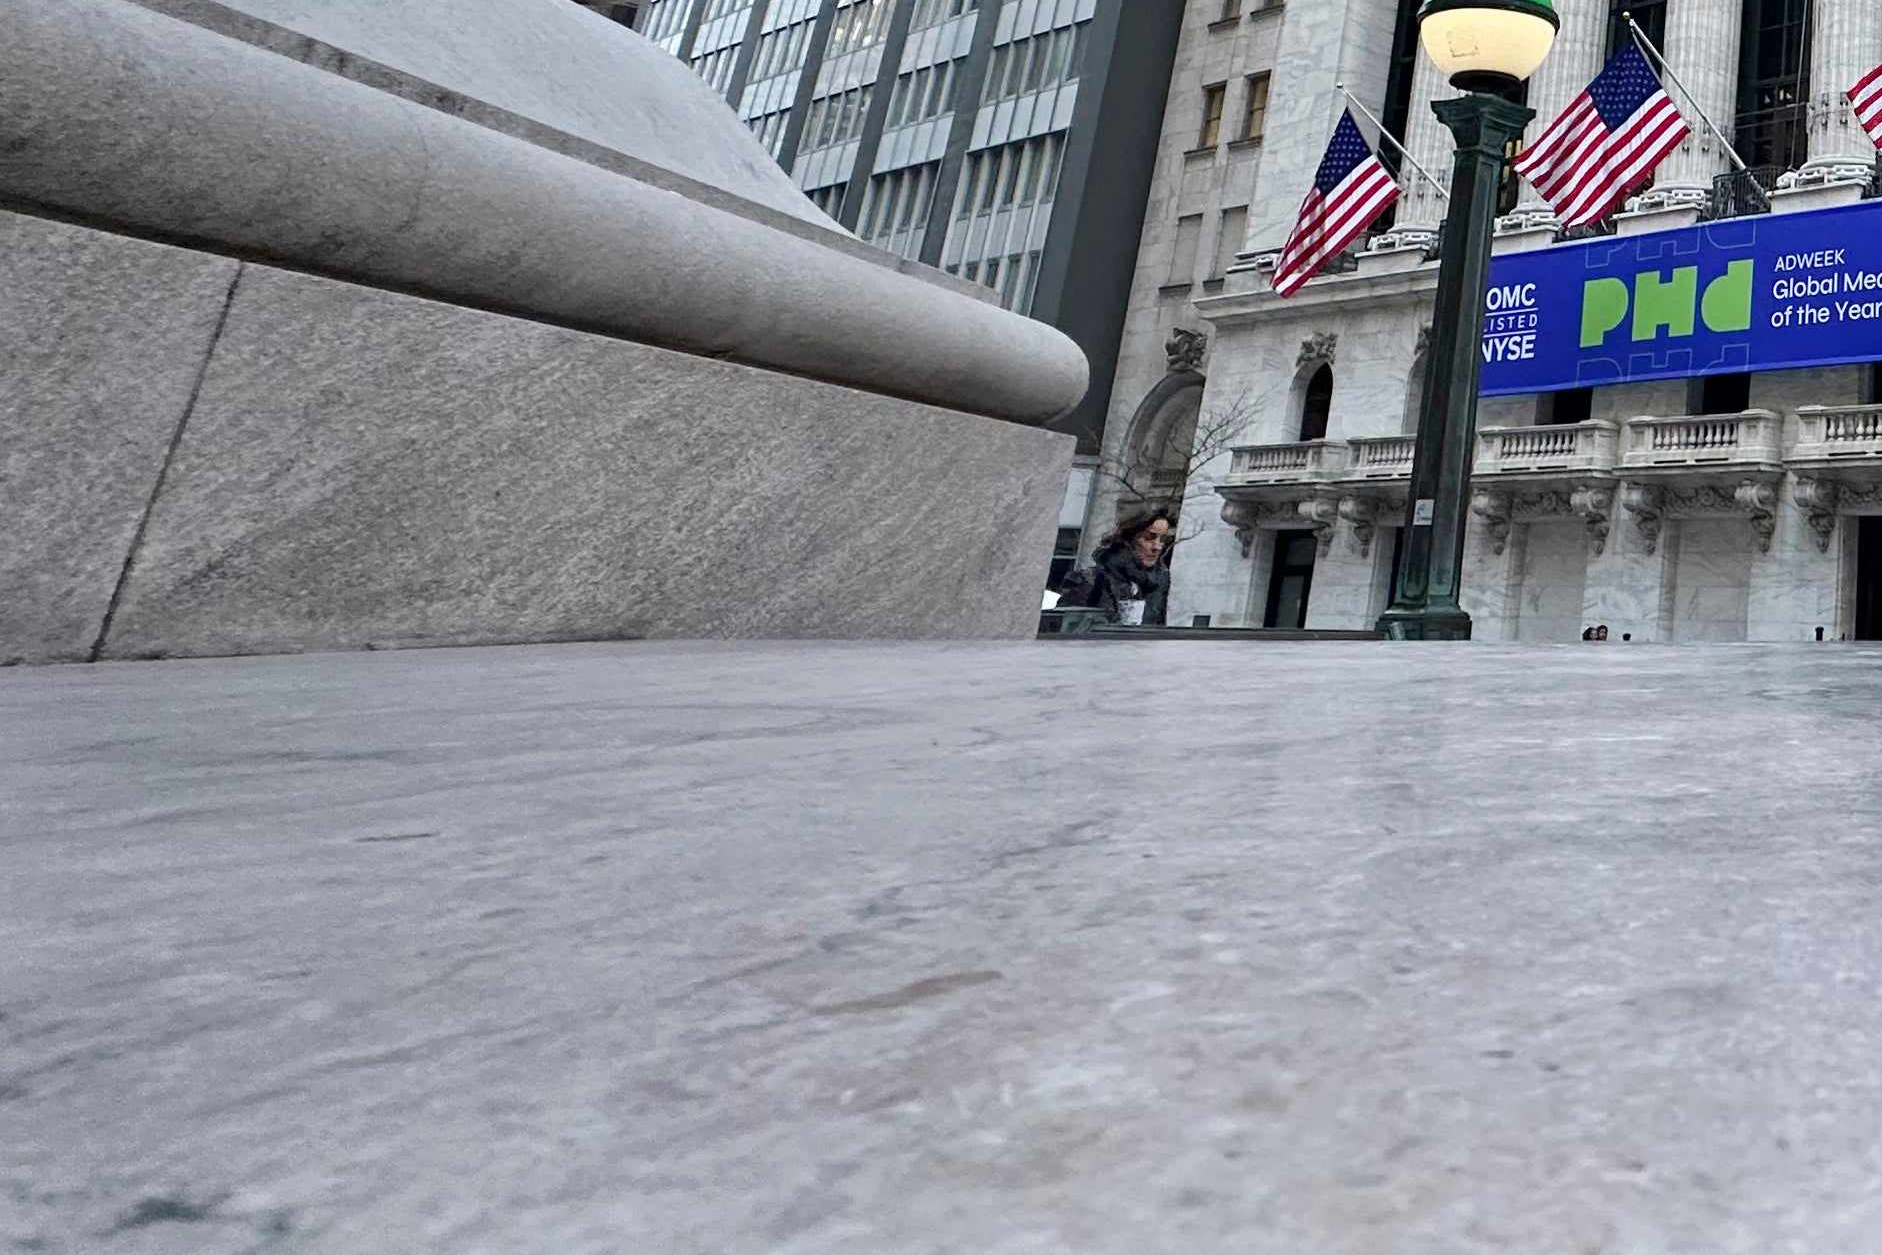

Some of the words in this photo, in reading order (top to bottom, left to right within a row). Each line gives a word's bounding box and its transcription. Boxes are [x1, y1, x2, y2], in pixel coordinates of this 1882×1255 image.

[1774, 248, 1845, 272] ADWEEK
[1486, 283, 1536, 310] OMC
[1772, 272, 1838, 300] Global
[1483, 314, 1538, 333] ISTED
[1771, 305, 1793, 328] of
[1796, 303, 1830, 325] the
[1482, 334, 1537, 363] NYSE
